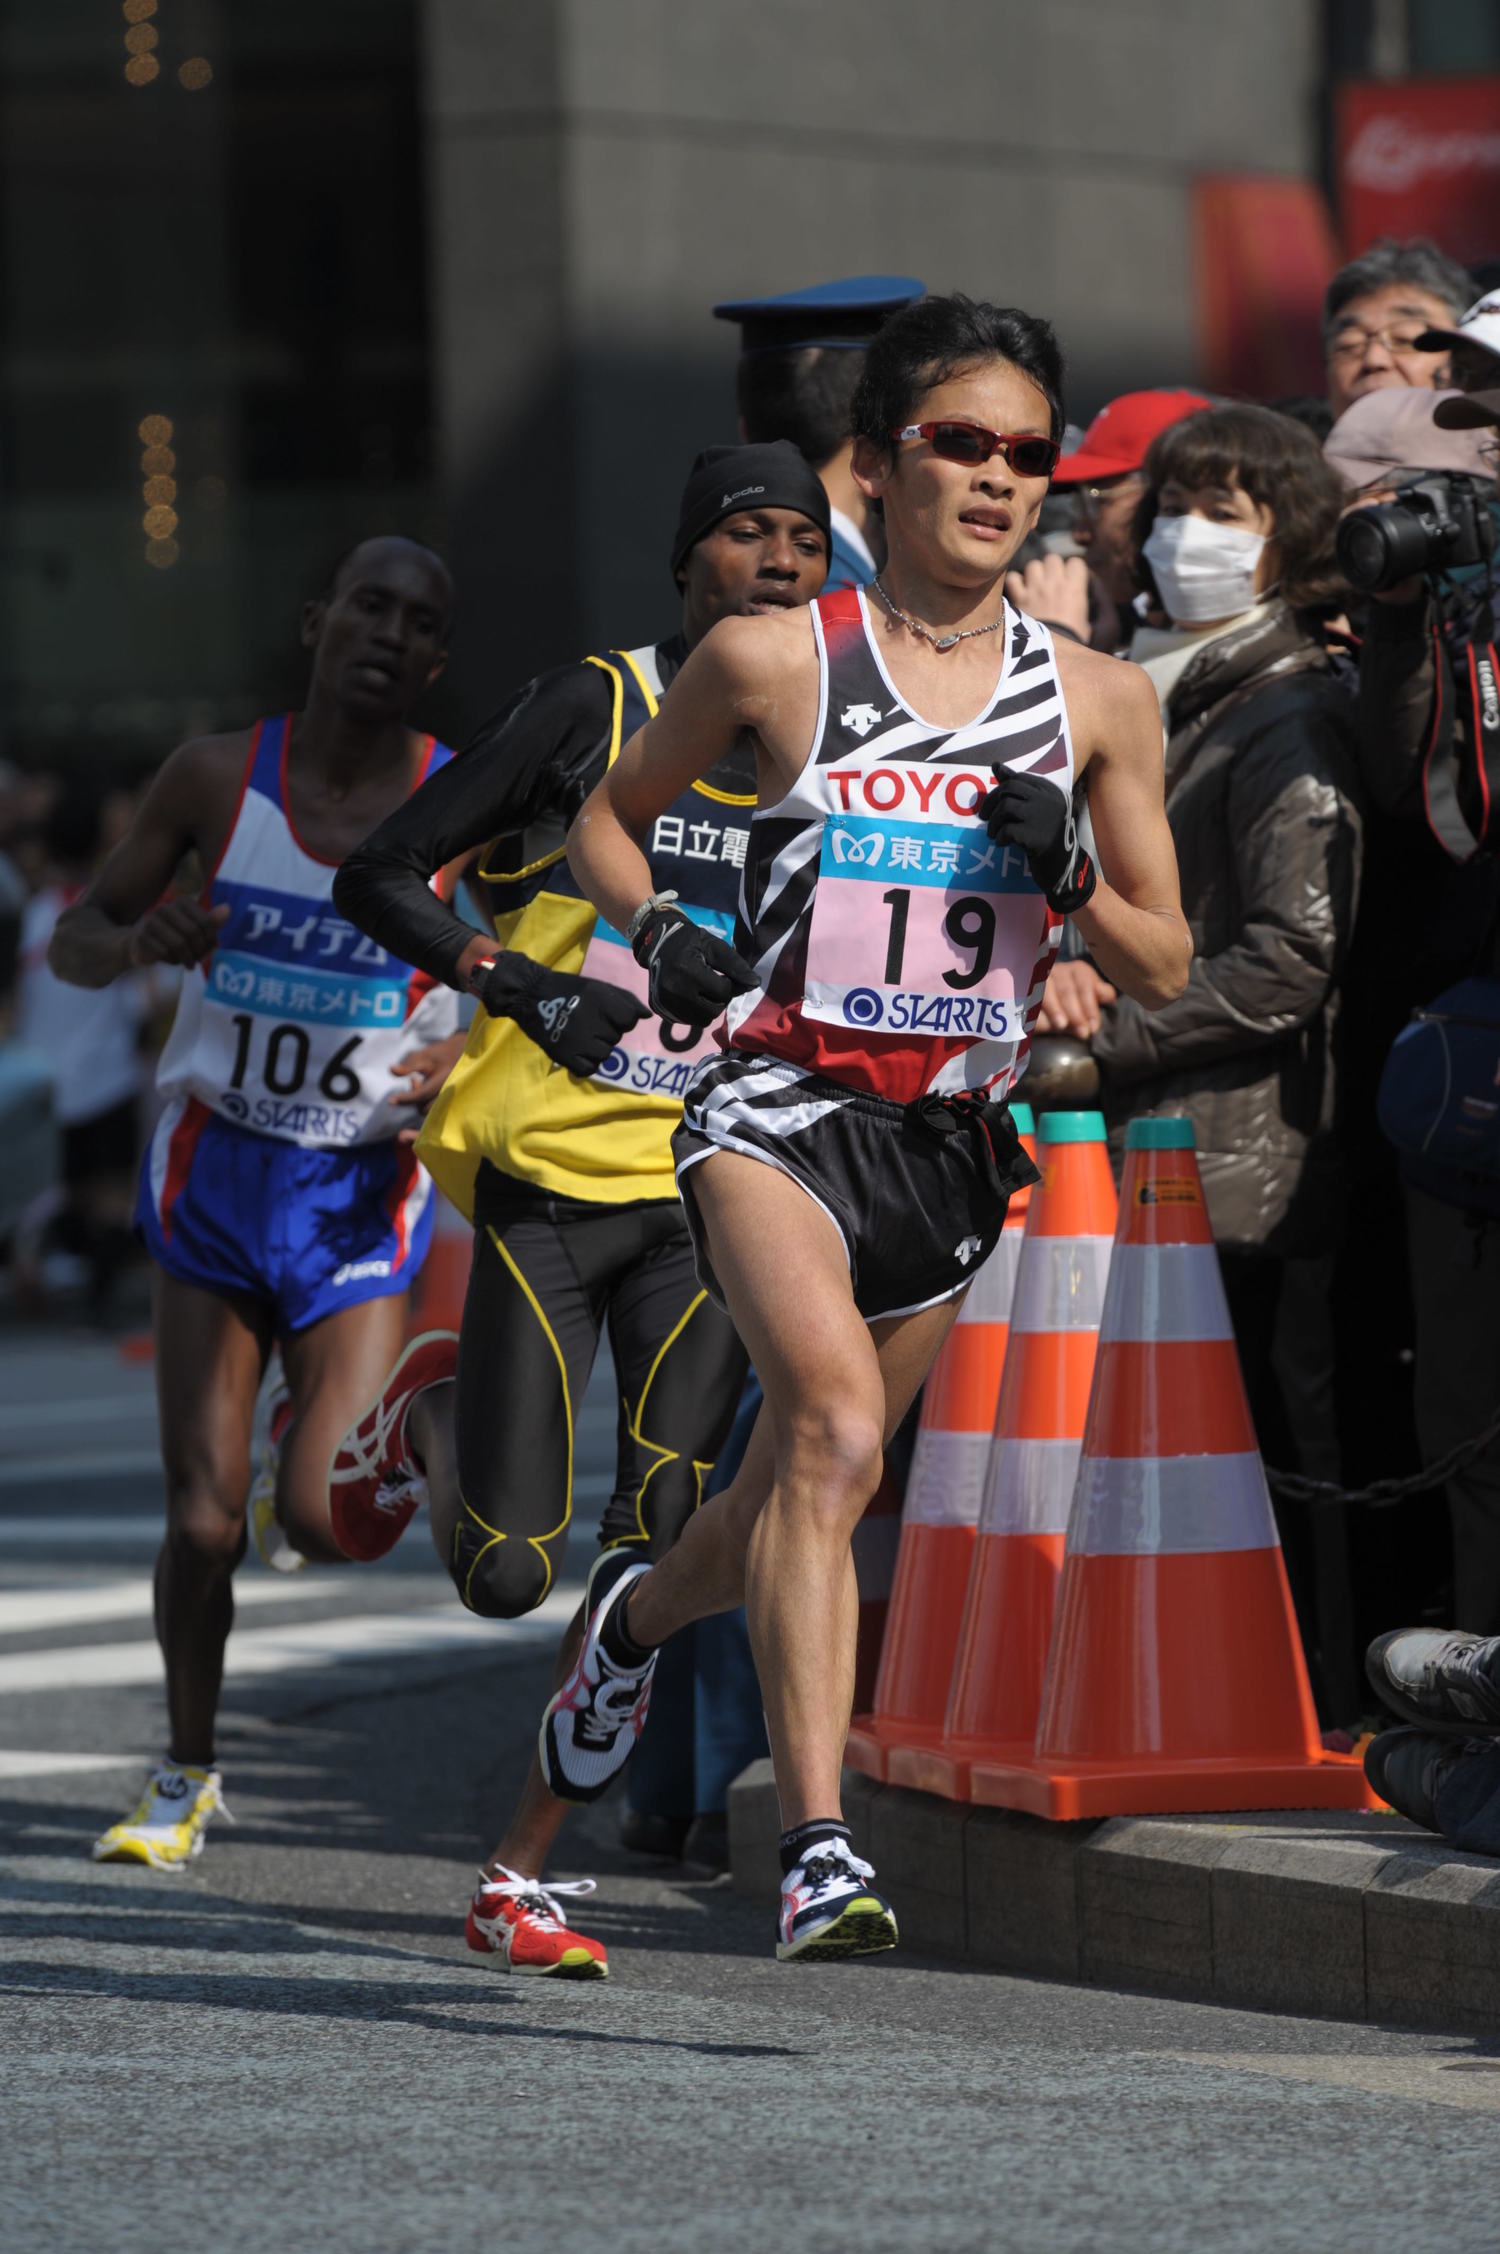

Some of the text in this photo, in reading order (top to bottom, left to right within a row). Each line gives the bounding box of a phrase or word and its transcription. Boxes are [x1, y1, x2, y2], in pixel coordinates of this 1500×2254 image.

[1478, 660, 1500, 729] Canon
[827, 769, 1000, 816] TOYO
[652, 815, 750, 868] 日立電
[246, 903, 388, 966] アイテム
[883, 888, 997, 990] 19
[257, 976, 401, 1017] 東京メトロ
[888, 993, 1007, 1037] STARTS
[232, 1014, 364, 1101] 106
[631, 1056, 697, 1096] STA
[251, 1102, 361, 1140] STARTS
